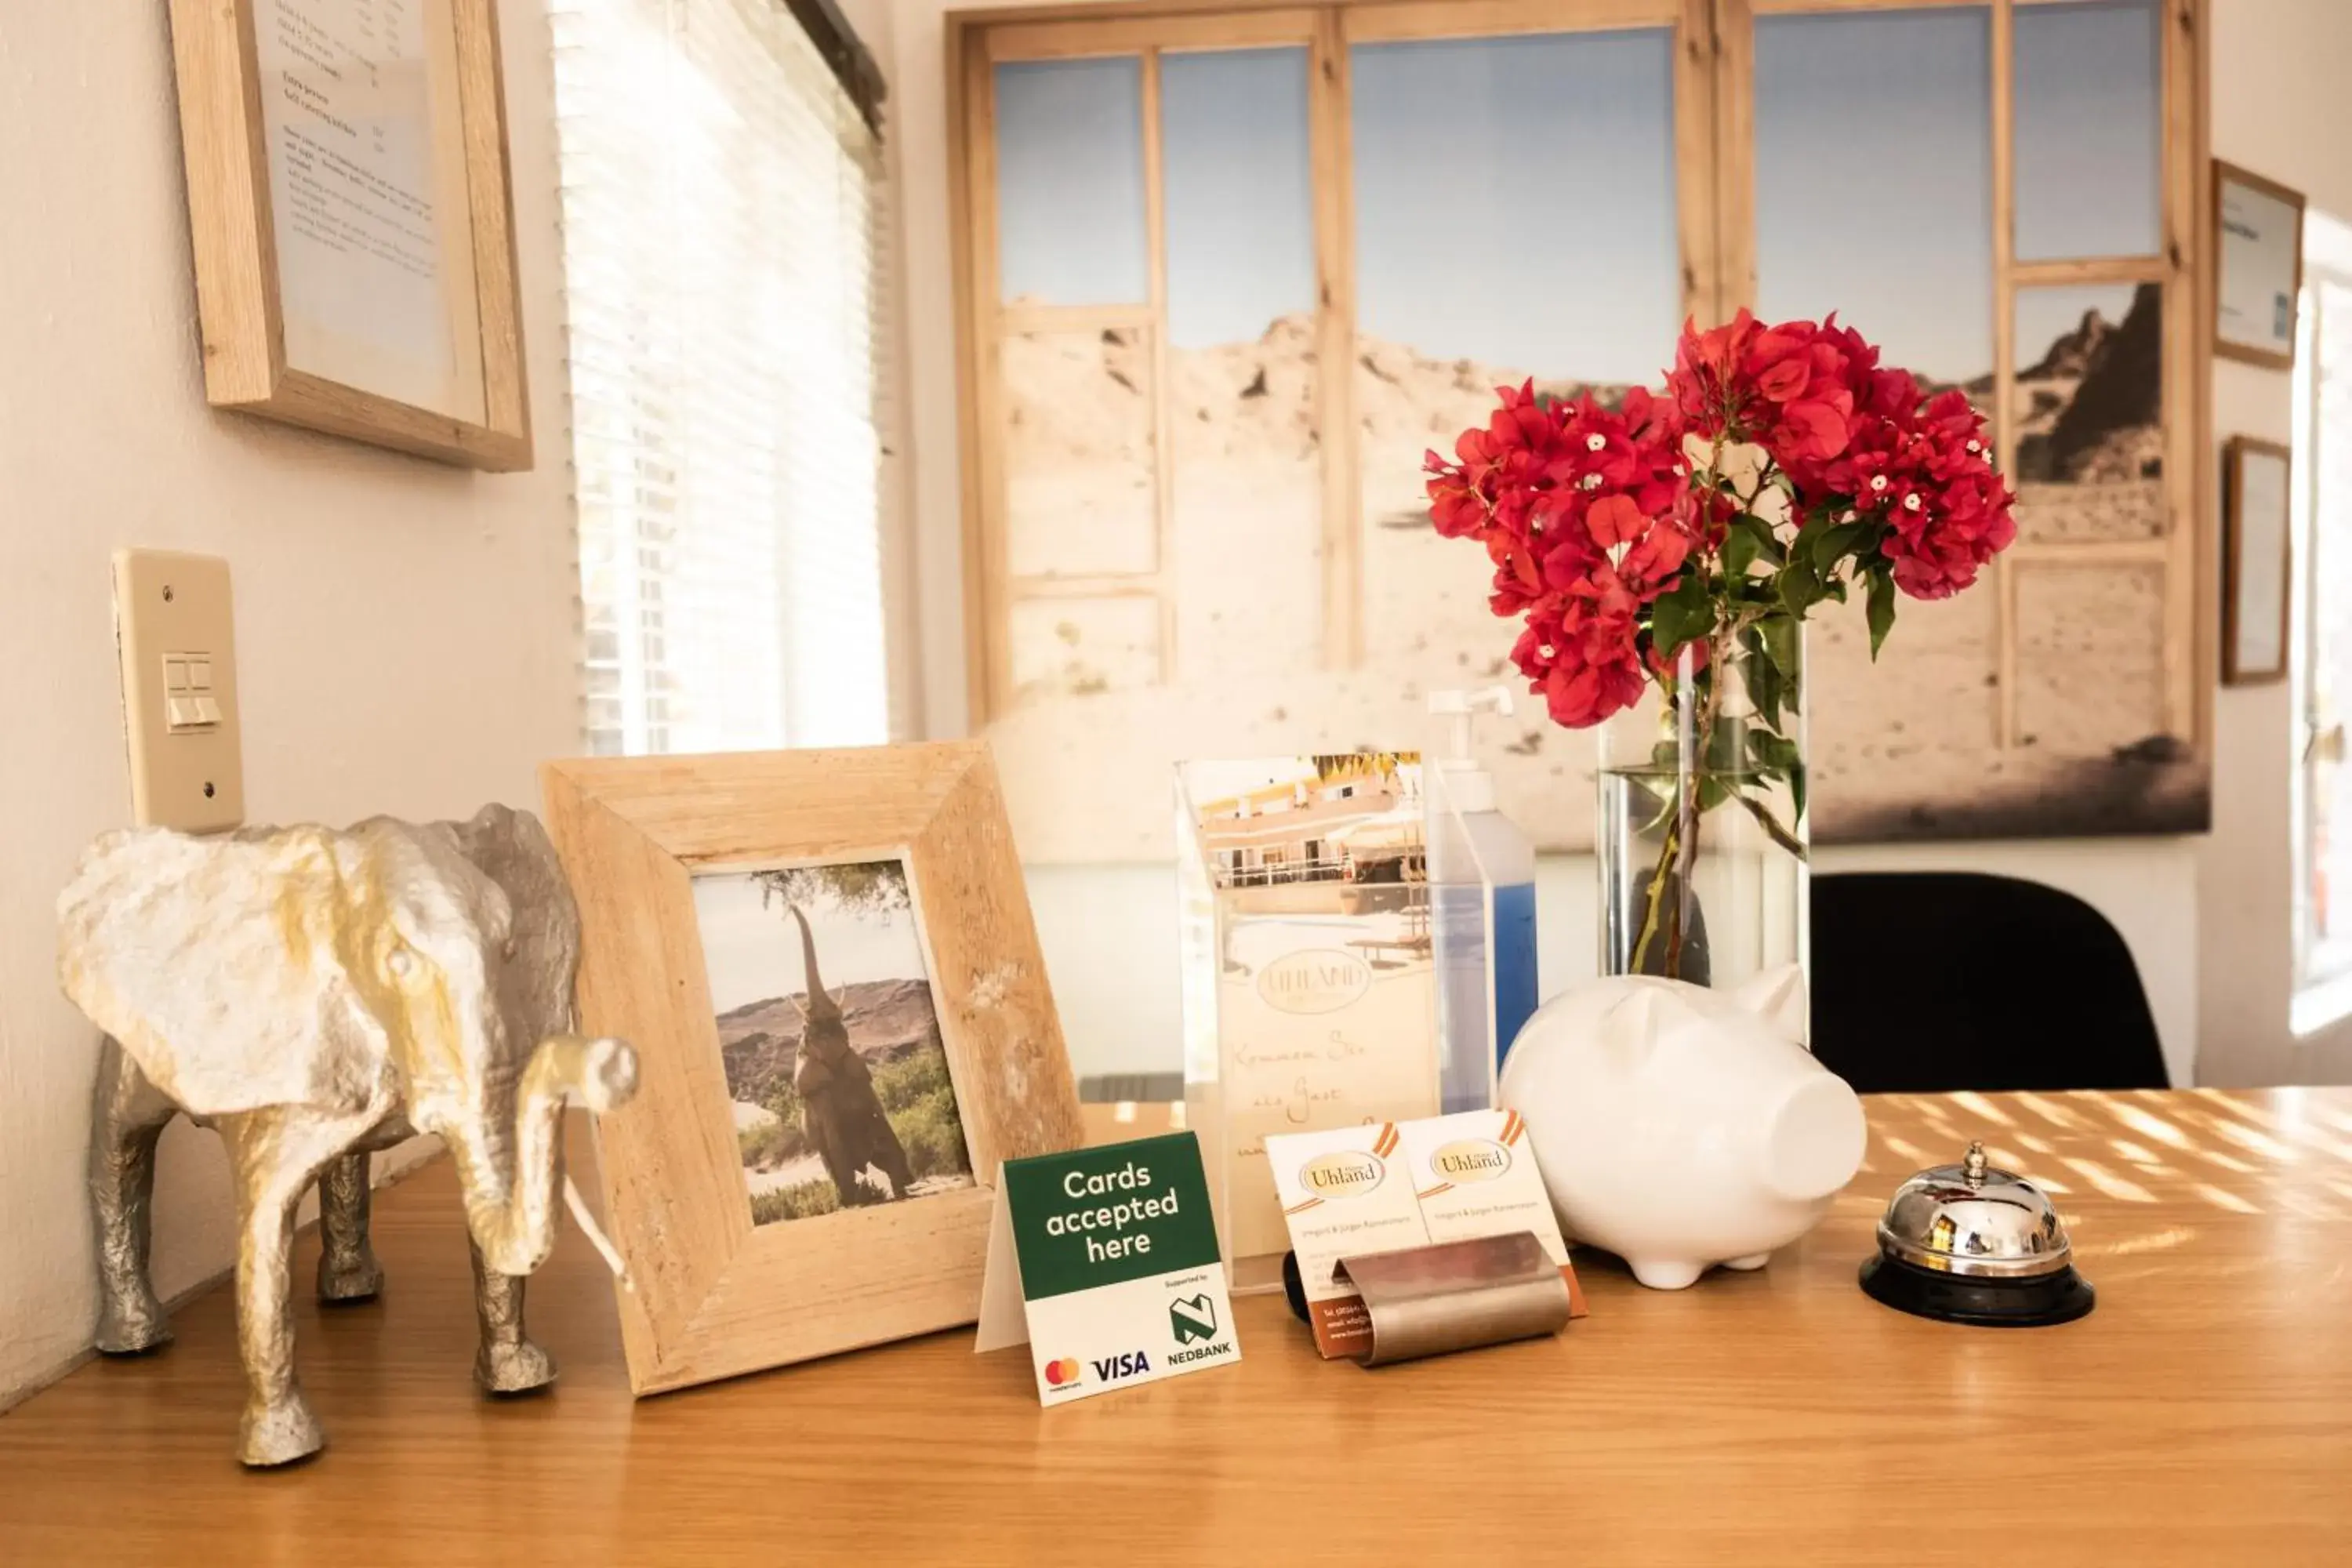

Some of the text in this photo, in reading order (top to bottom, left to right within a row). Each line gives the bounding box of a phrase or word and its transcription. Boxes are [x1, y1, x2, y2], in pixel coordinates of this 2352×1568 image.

[1311, 1163, 1376, 1188] Uhland
[1441, 1149, 1504, 1173] Uhland
[1063, 1161, 1151, 1198] Cards
[1046, 1188, 1179, 1236] accepted
[1086, 1232, 1151, 1264] here
[1089, 1351, 1150, 1382] VISA
[1167, 1341, 1232, 1366] NEDBANK
